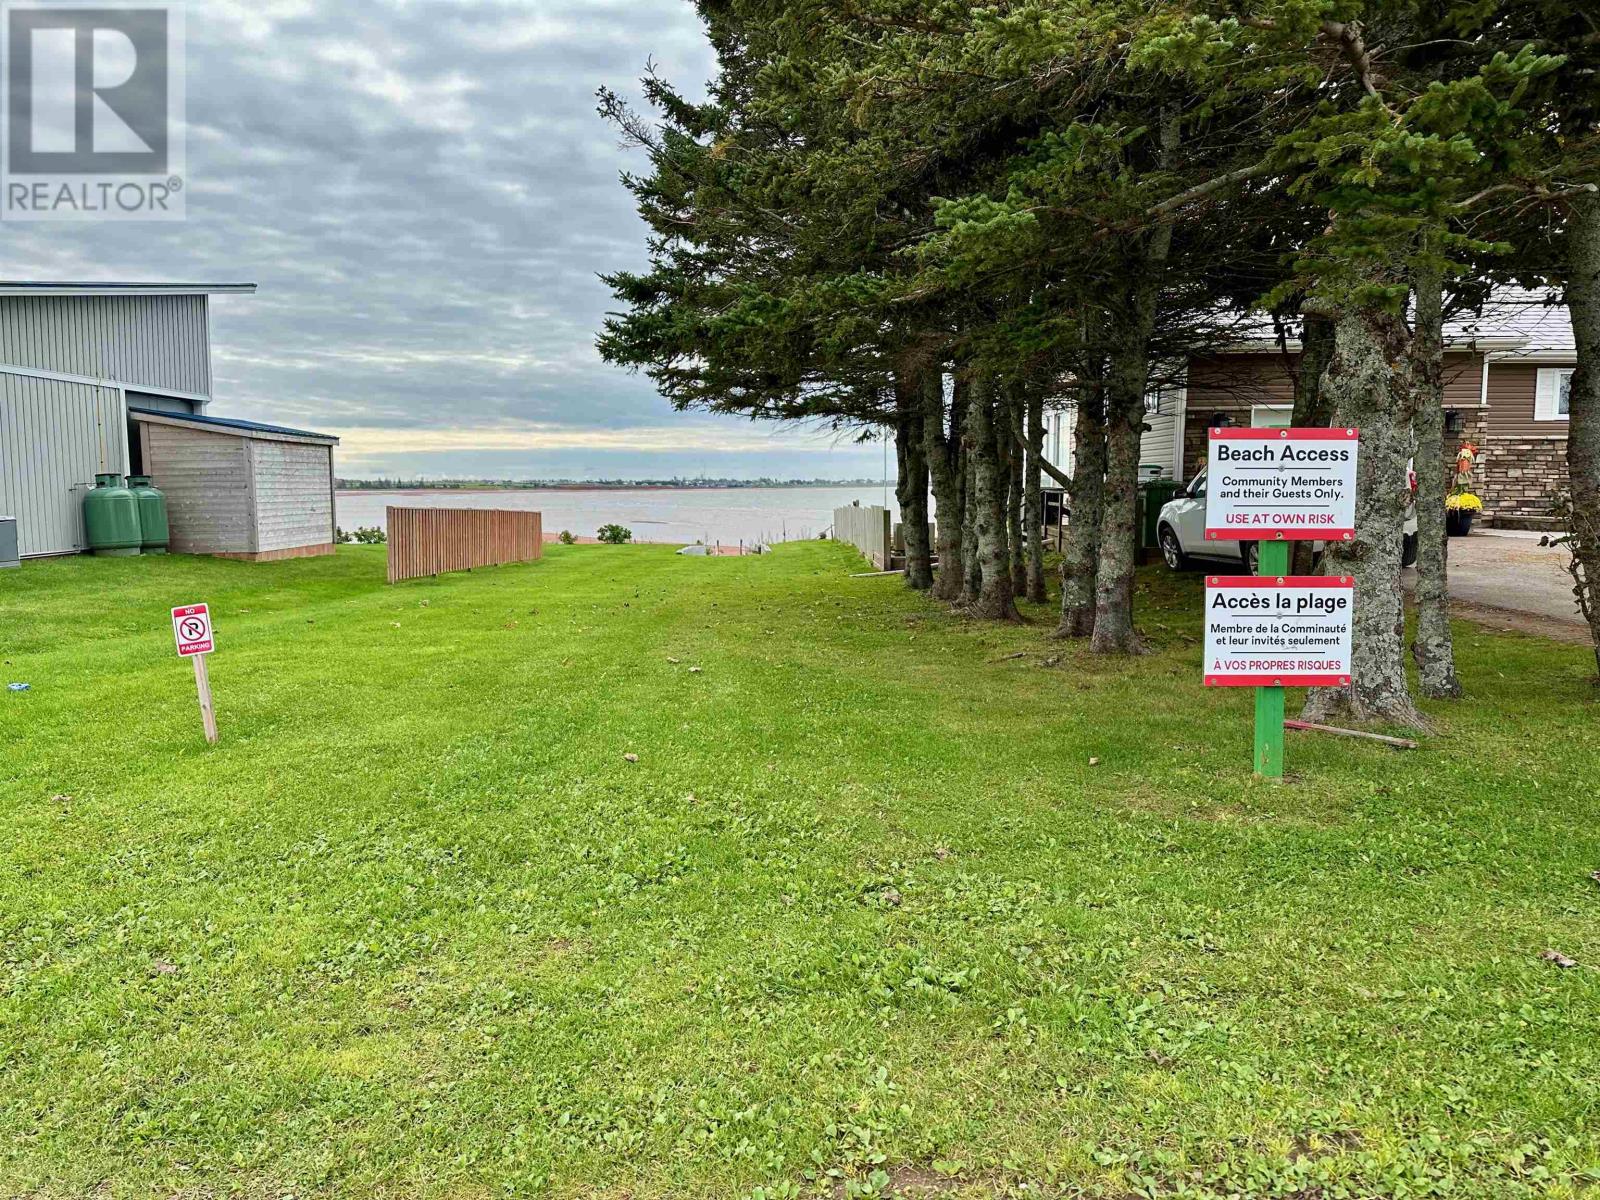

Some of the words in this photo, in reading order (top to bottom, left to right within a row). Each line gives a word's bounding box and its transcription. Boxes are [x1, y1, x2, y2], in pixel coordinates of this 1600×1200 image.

[1218, 445, 1274, 461] Beach
[1280, 445, 1349, 461] Access
[1222, 476, 1287, 488] Community
[1291, 477, 1343, 486] Members
[1220, 489, 1240, 498] and
[1243, 489, 1269, 498] their
[1273, 489, 1311, 498] Guests
[1314, 489, 1343, 500] Only.
[1226, 514, 1249, 523] USE
[1252, 514, 1269, 523] AT
[1273, 514, 1305, 523] OWN
[1308, 514, 1335, 523] RISK
[1212, 593, 1270, 609] Accès
[1276, 593, 1291, 609] la
[1297, 593, 1347, 613] plage
[1210, 624, 1252, 633] Membre
[1255, 624, 1268, 633] de
[1270, 624, 1279, 633] la
[1281, 624, 1346, 633] Comminauté
[1216, 637, 1226, 645] et
[1229, 636, 1248, 645] leur
[1251, 636, 1285, 645] invités
[1288, 636, 1340, 645] seulement
[181, 642, 210, 652] PARKING
[1214, 658, 1221, 670] À
[1224, 661, 1246, 670] VOS
[1250, 661, 1295, 670] PROPRES
[1298, 661, 1341, 670] RISQUES
